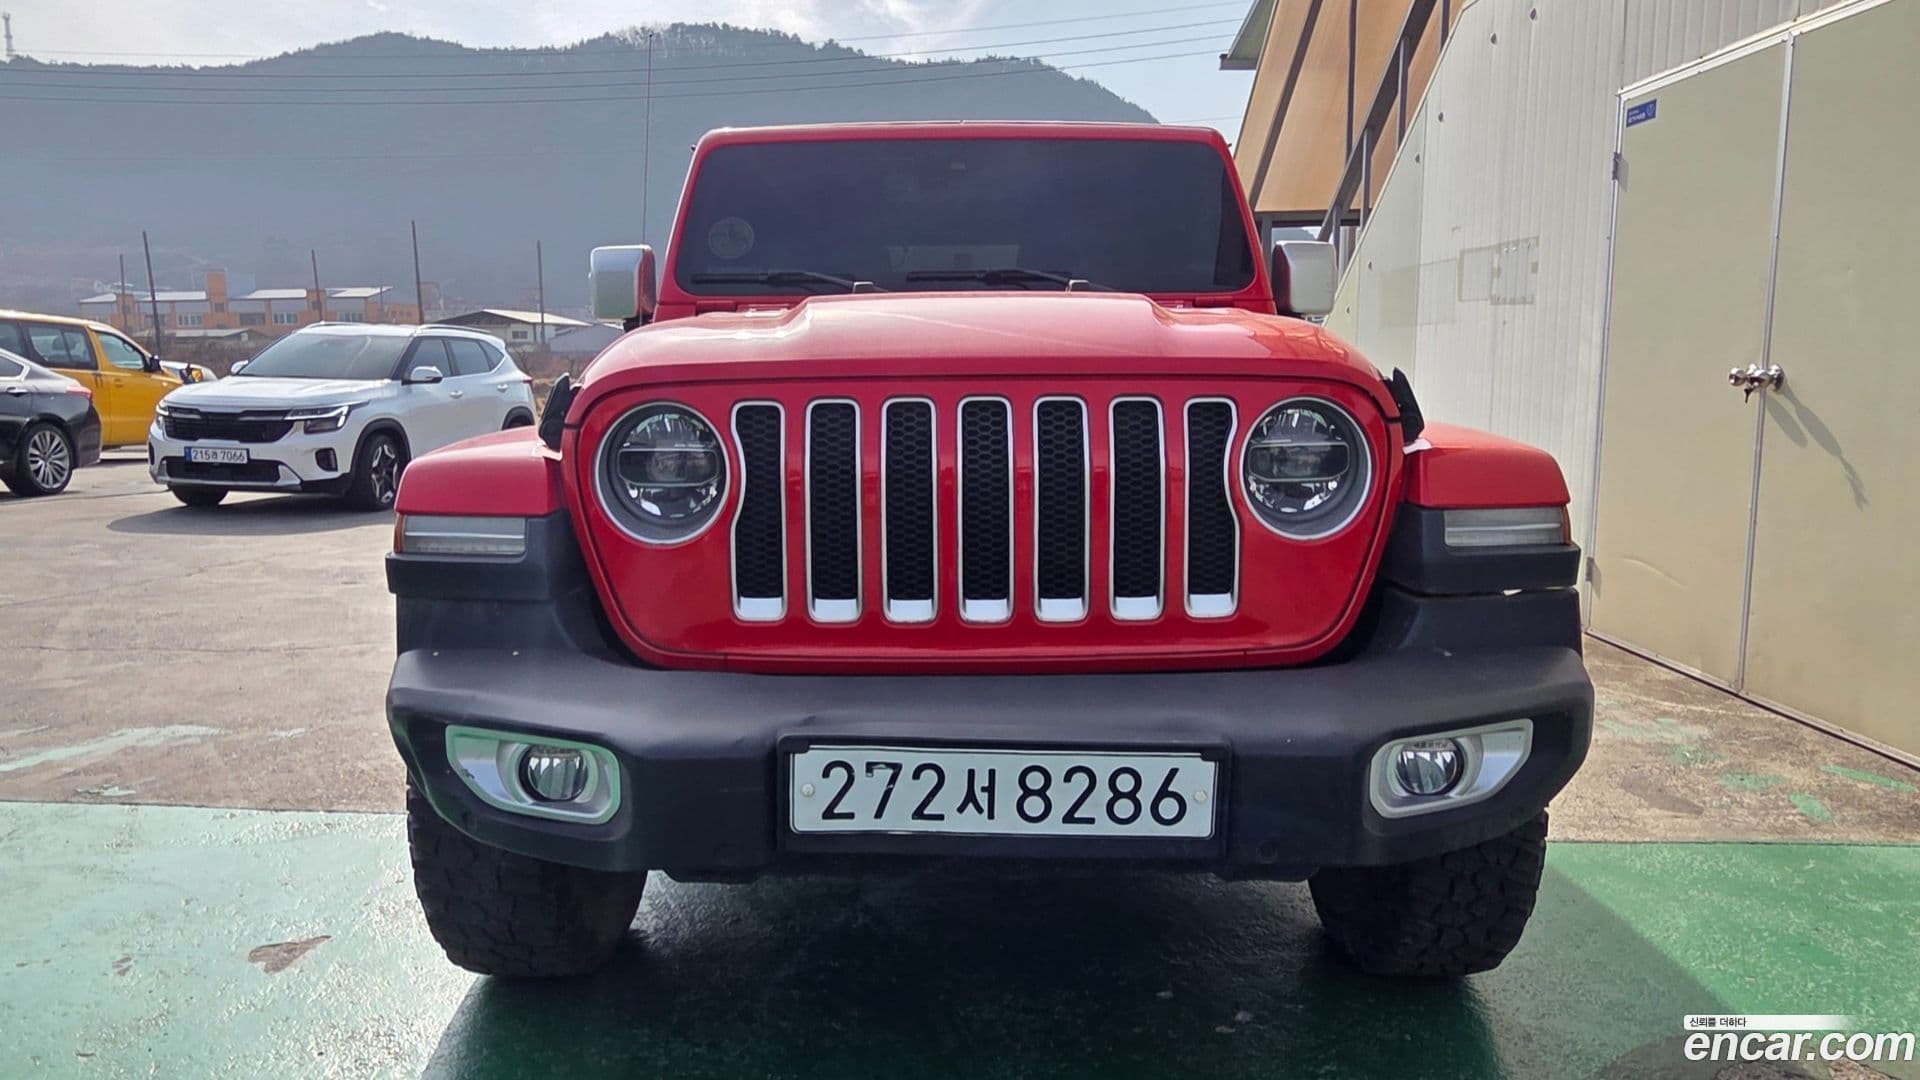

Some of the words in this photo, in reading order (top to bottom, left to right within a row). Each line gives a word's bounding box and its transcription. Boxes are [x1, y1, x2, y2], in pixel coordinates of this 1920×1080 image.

[220, 450, 245, 462] 7066
[821, 760, 997, 821] 272서
[1015, 764, 1188, 826] 8286
